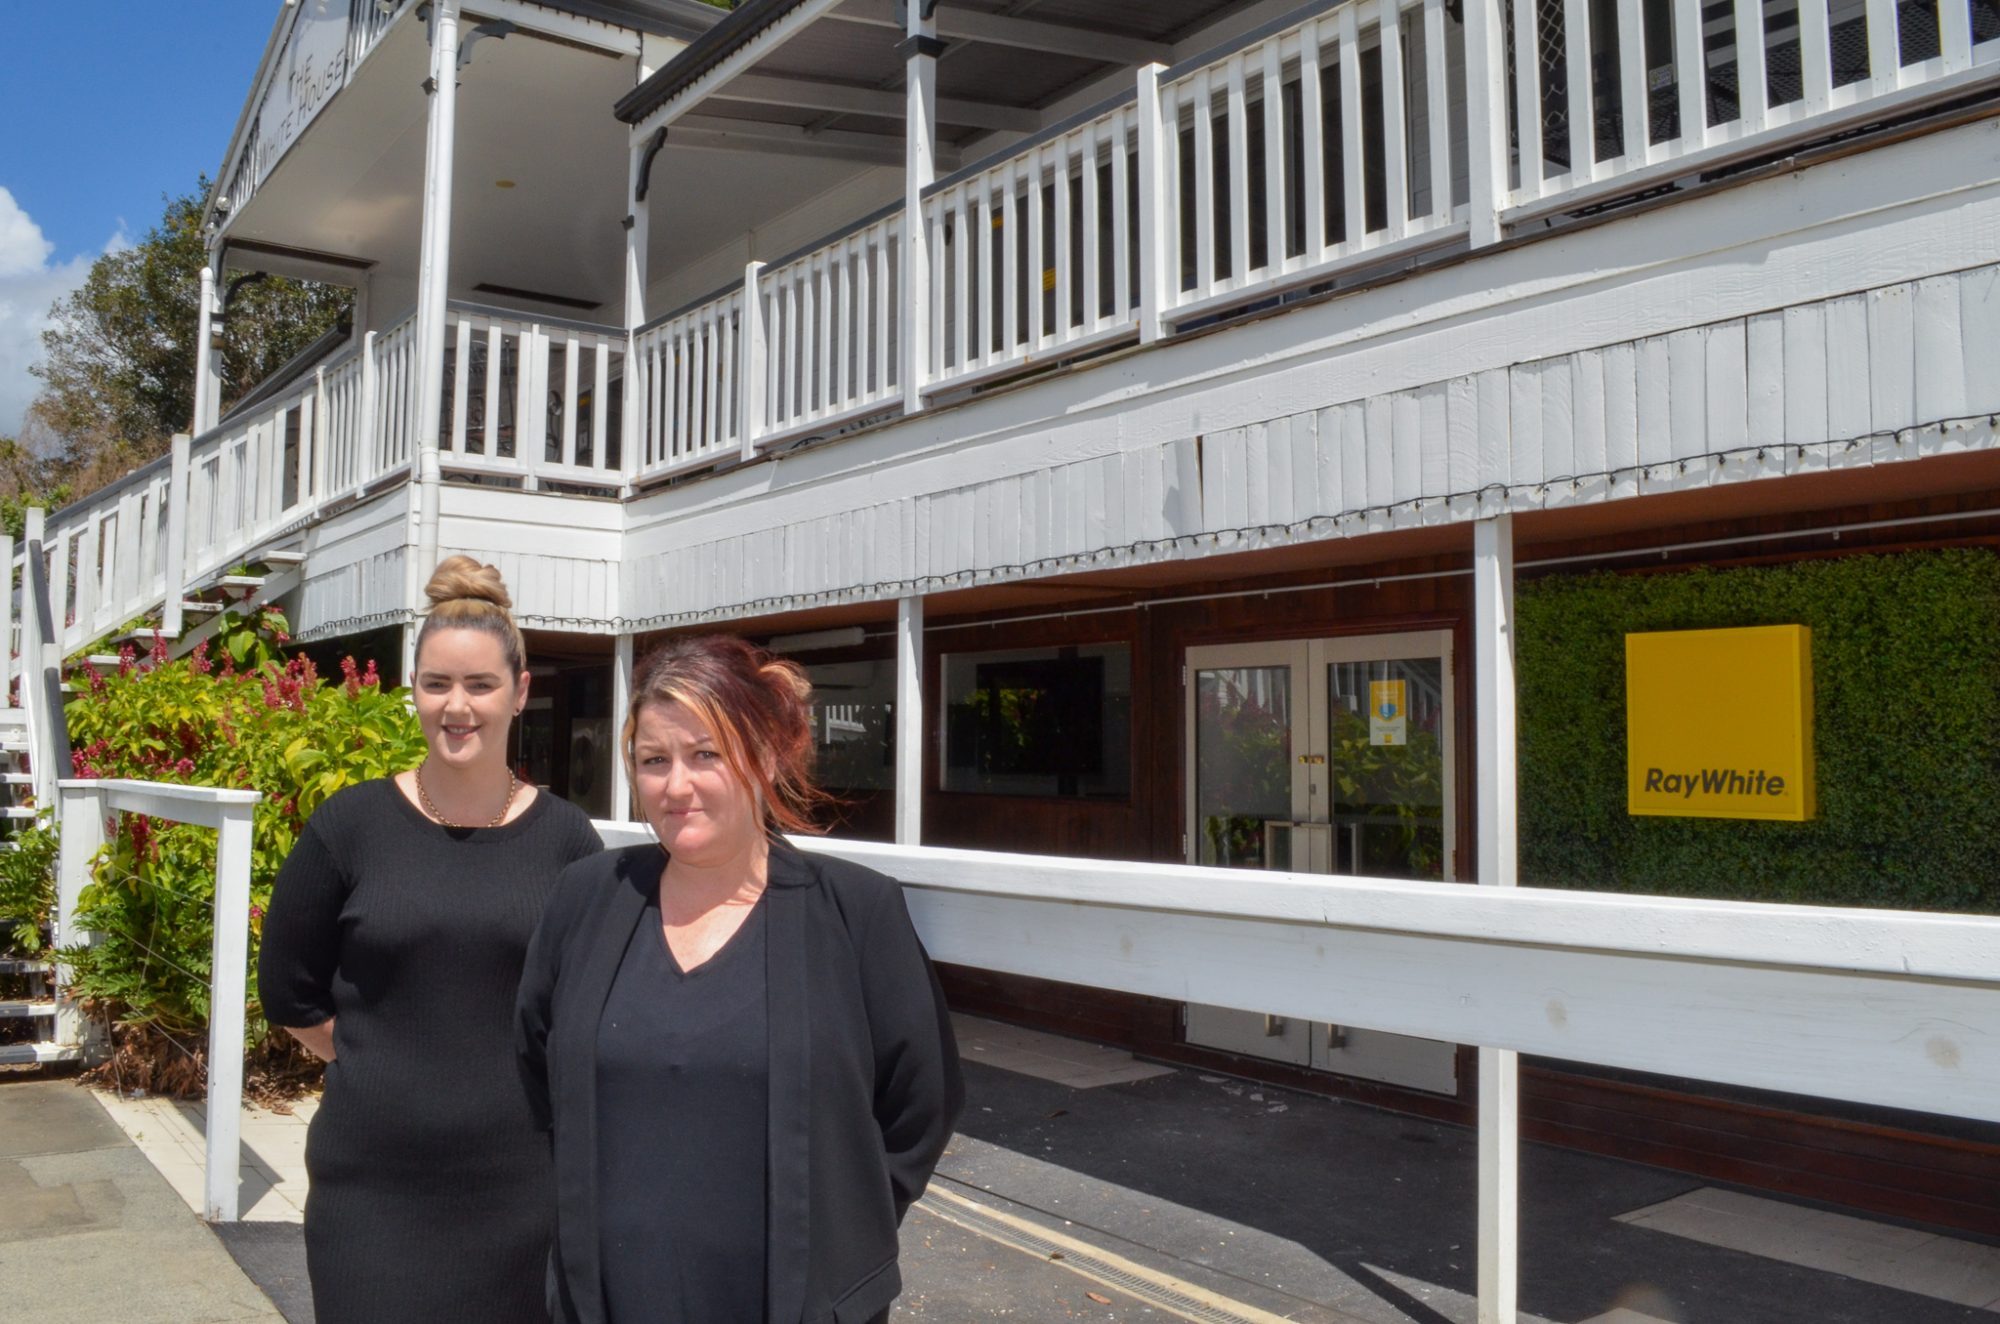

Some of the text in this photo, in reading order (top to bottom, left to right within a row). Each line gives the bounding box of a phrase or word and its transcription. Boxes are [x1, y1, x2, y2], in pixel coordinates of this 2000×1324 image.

[260, 49, 344, 171] WHITE HOUSE
[289, 54, 313, 103] THE
